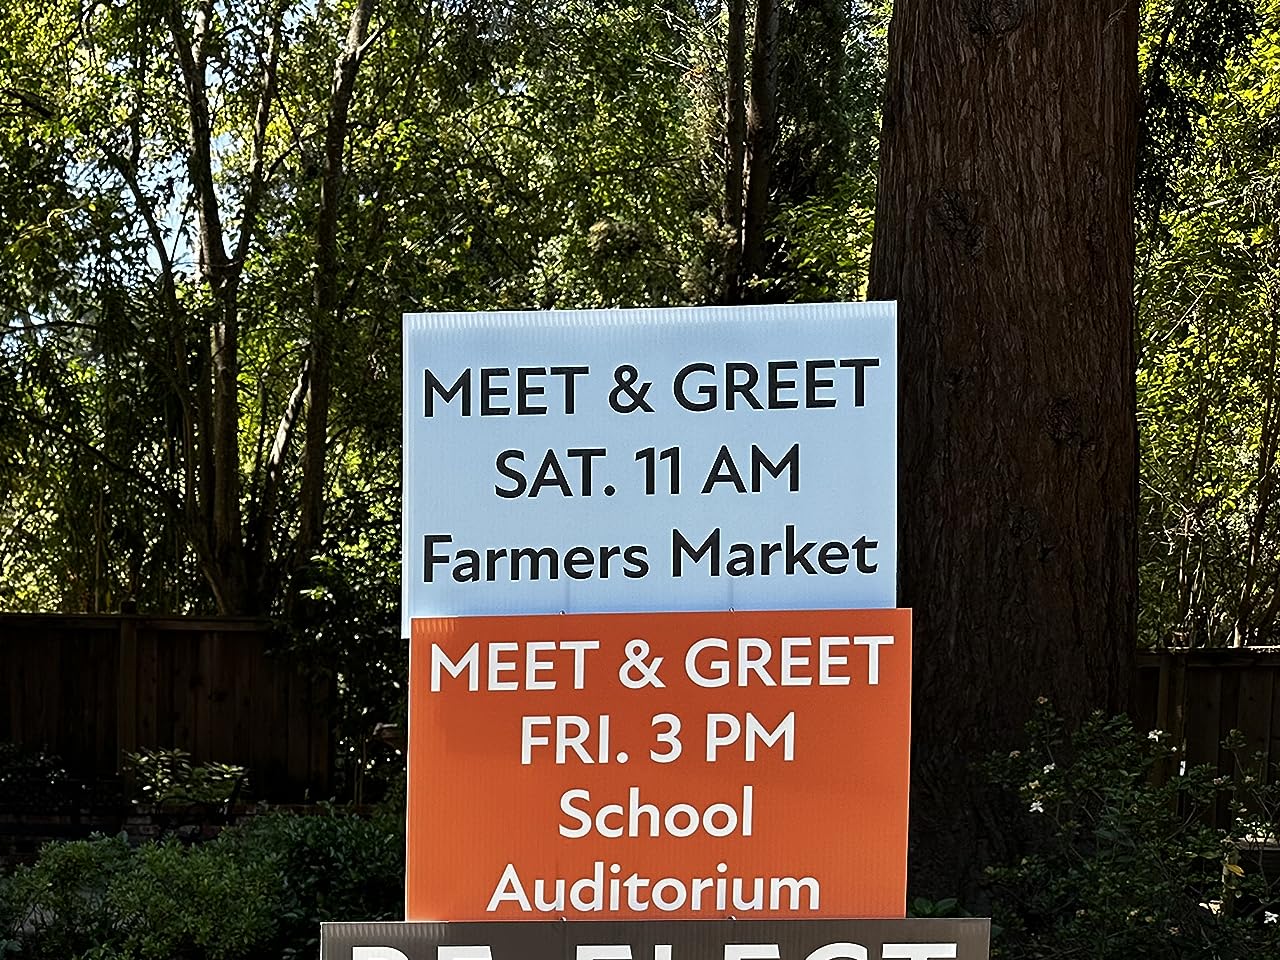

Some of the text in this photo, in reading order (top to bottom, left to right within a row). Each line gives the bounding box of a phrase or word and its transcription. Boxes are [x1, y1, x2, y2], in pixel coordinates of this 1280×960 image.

[422, 358, 880, 417] MEET & GREET
[493, 443, 802, 498] SAT. 11 AM
[422, 525, 878, 583] Farmers Market
[428, 635, 895, 691] MEET & GREET
[519, 712, 797, 764] FRI. 3 PM
[558, 786, 753, 838] School
[486, 862, 821, 913] Auditorium
